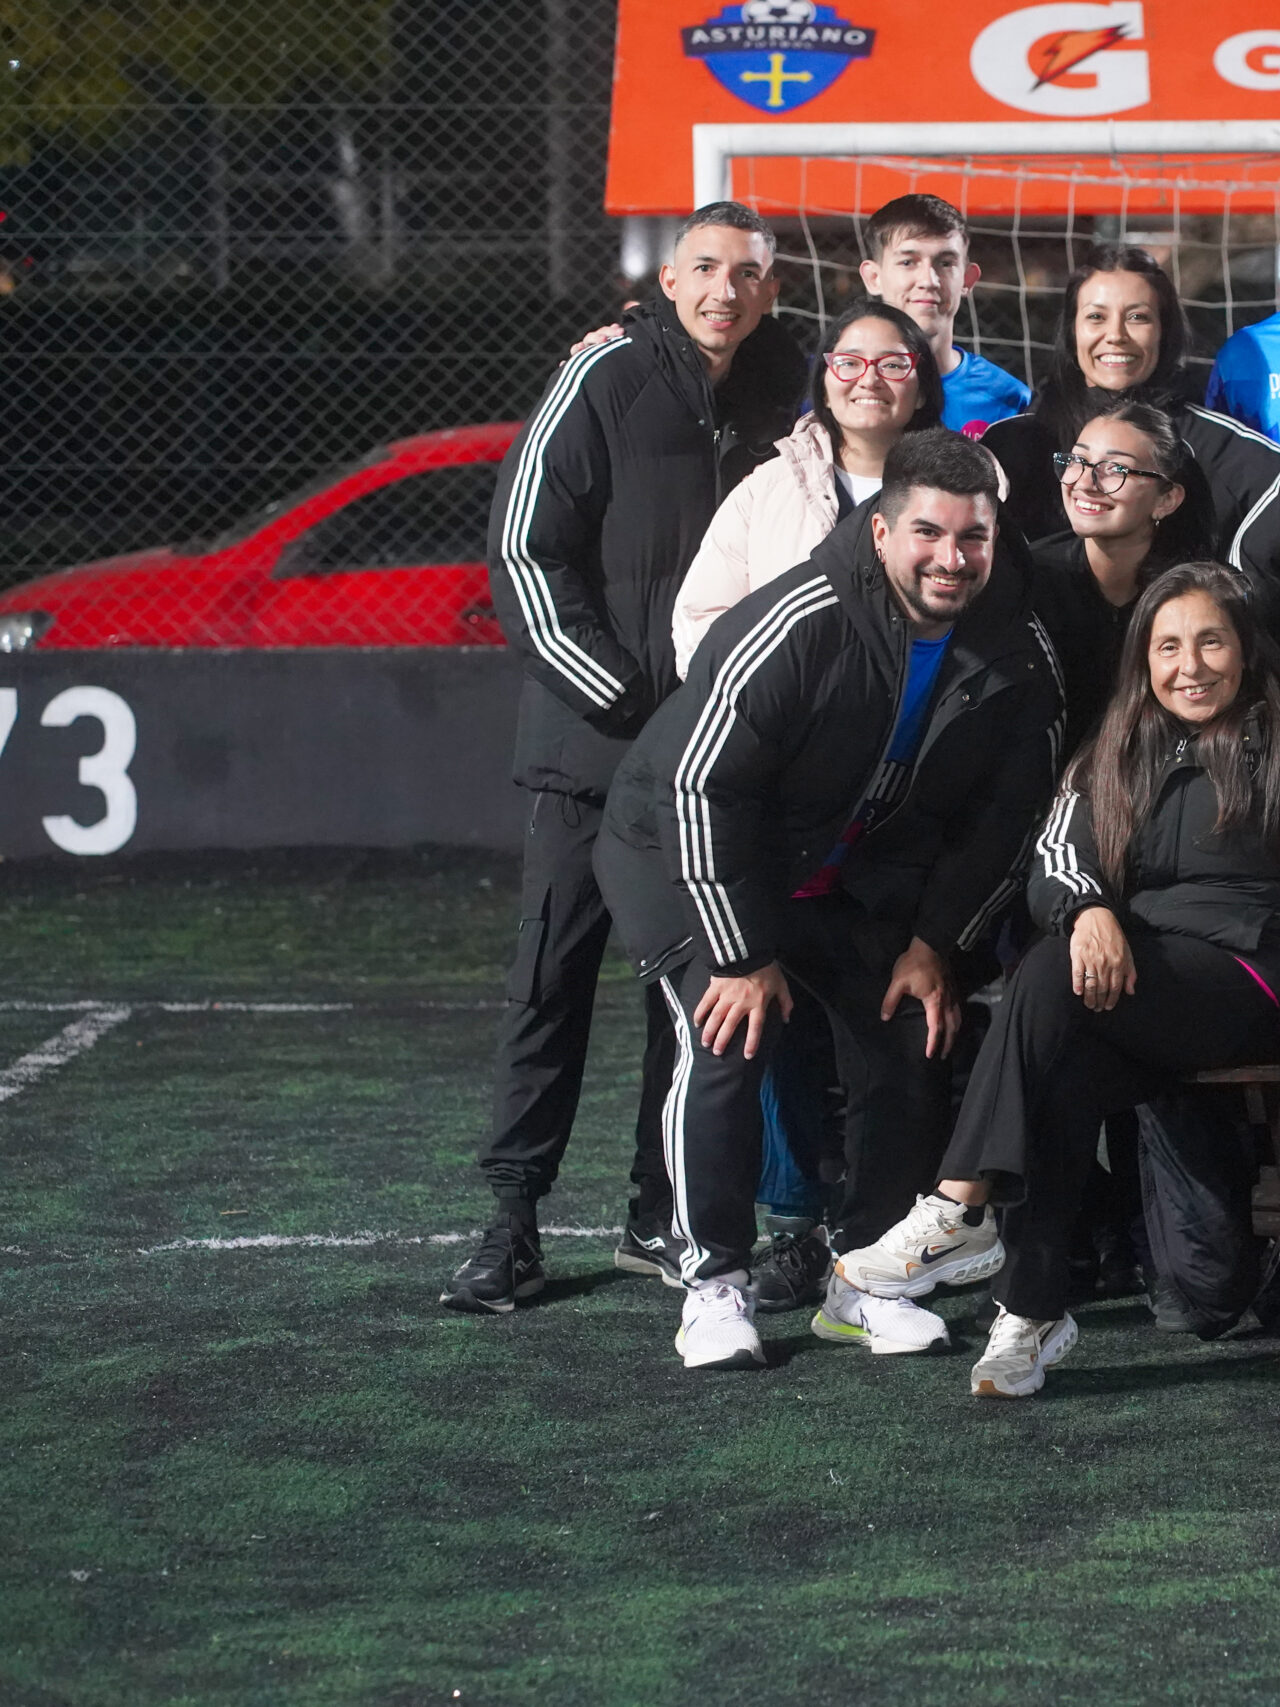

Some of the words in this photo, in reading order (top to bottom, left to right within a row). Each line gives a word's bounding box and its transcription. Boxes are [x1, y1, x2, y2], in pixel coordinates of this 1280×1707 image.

[691, 26, 867, 45] ASTURIANO
[970, 1, 1150, 117] G
[0, 685, 137, 855] 3
